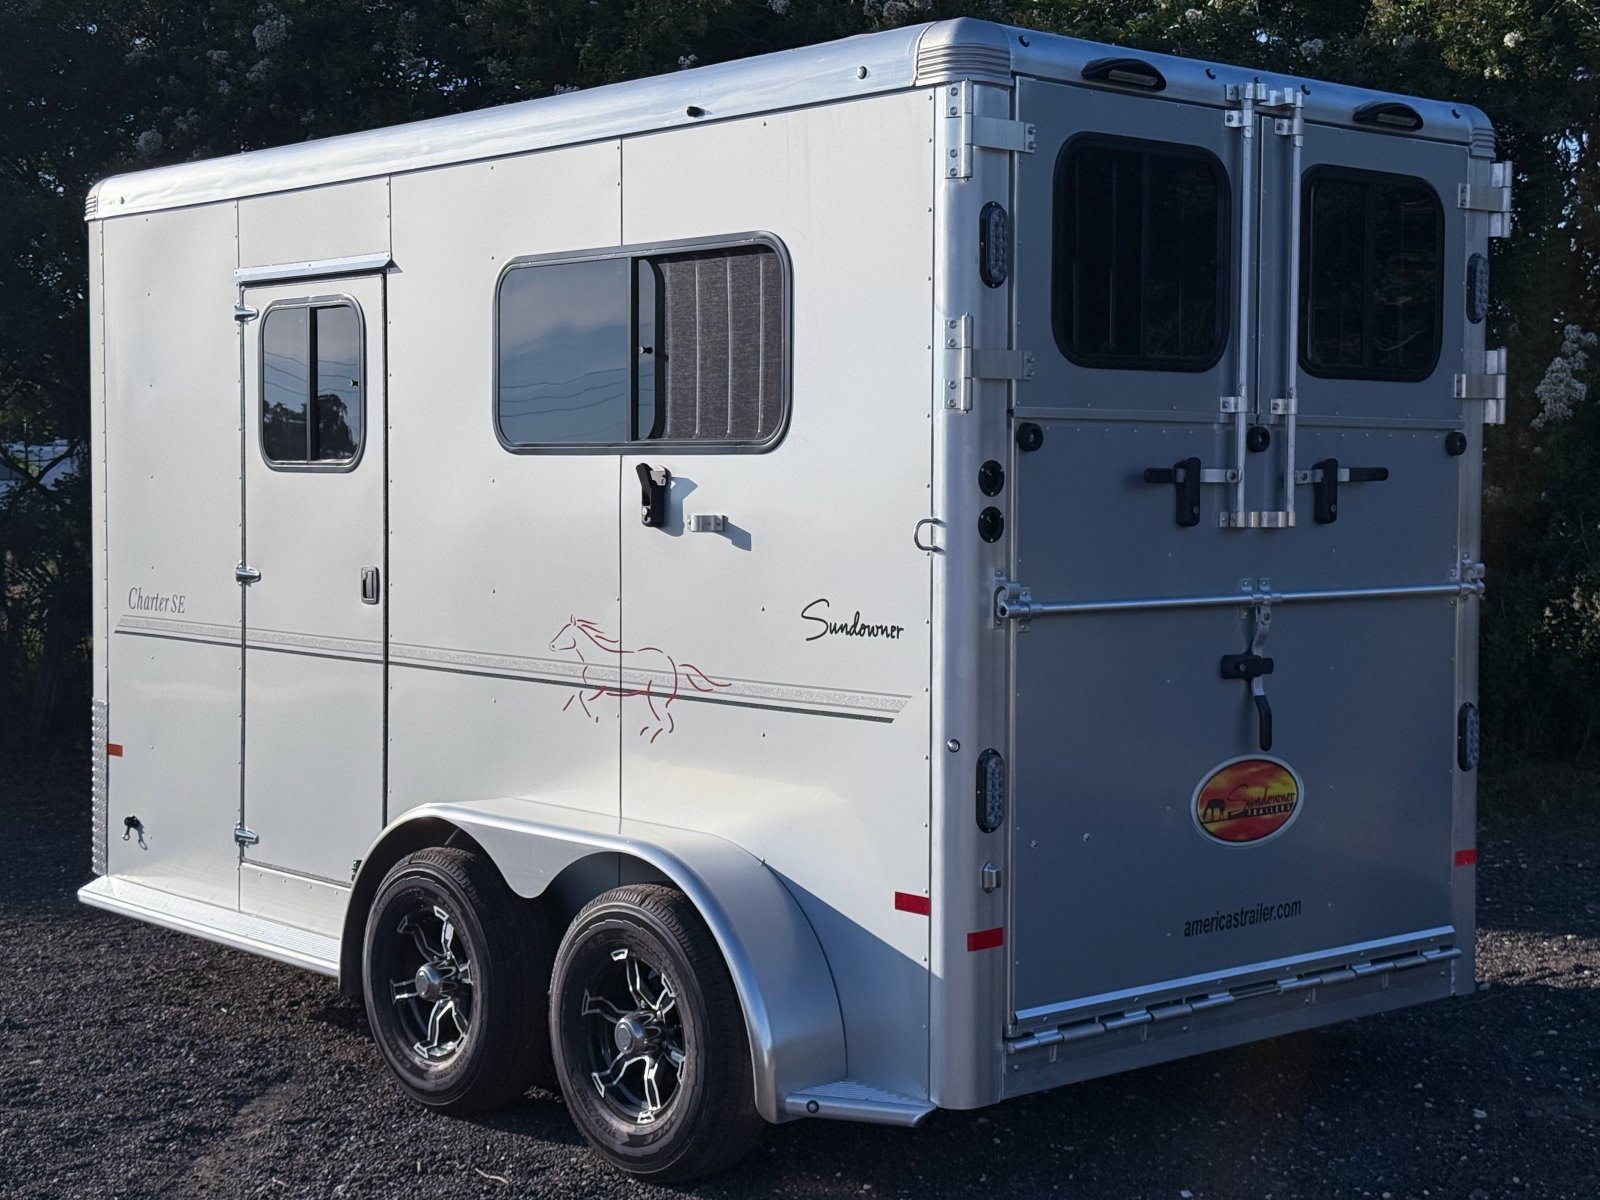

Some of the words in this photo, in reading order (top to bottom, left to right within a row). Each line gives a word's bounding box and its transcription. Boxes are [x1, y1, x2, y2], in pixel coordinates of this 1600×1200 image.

[128, 587, 169, 613] Charter
[170, 594, 186, 614] SE
[801, 598, 904, 641] Sundowner
[1226, 783, 1296, 809] Sundowner
[1247, 804, 1293, 817] TRAILERS
[1184, 900, 1302, 937] americastrailer.com
